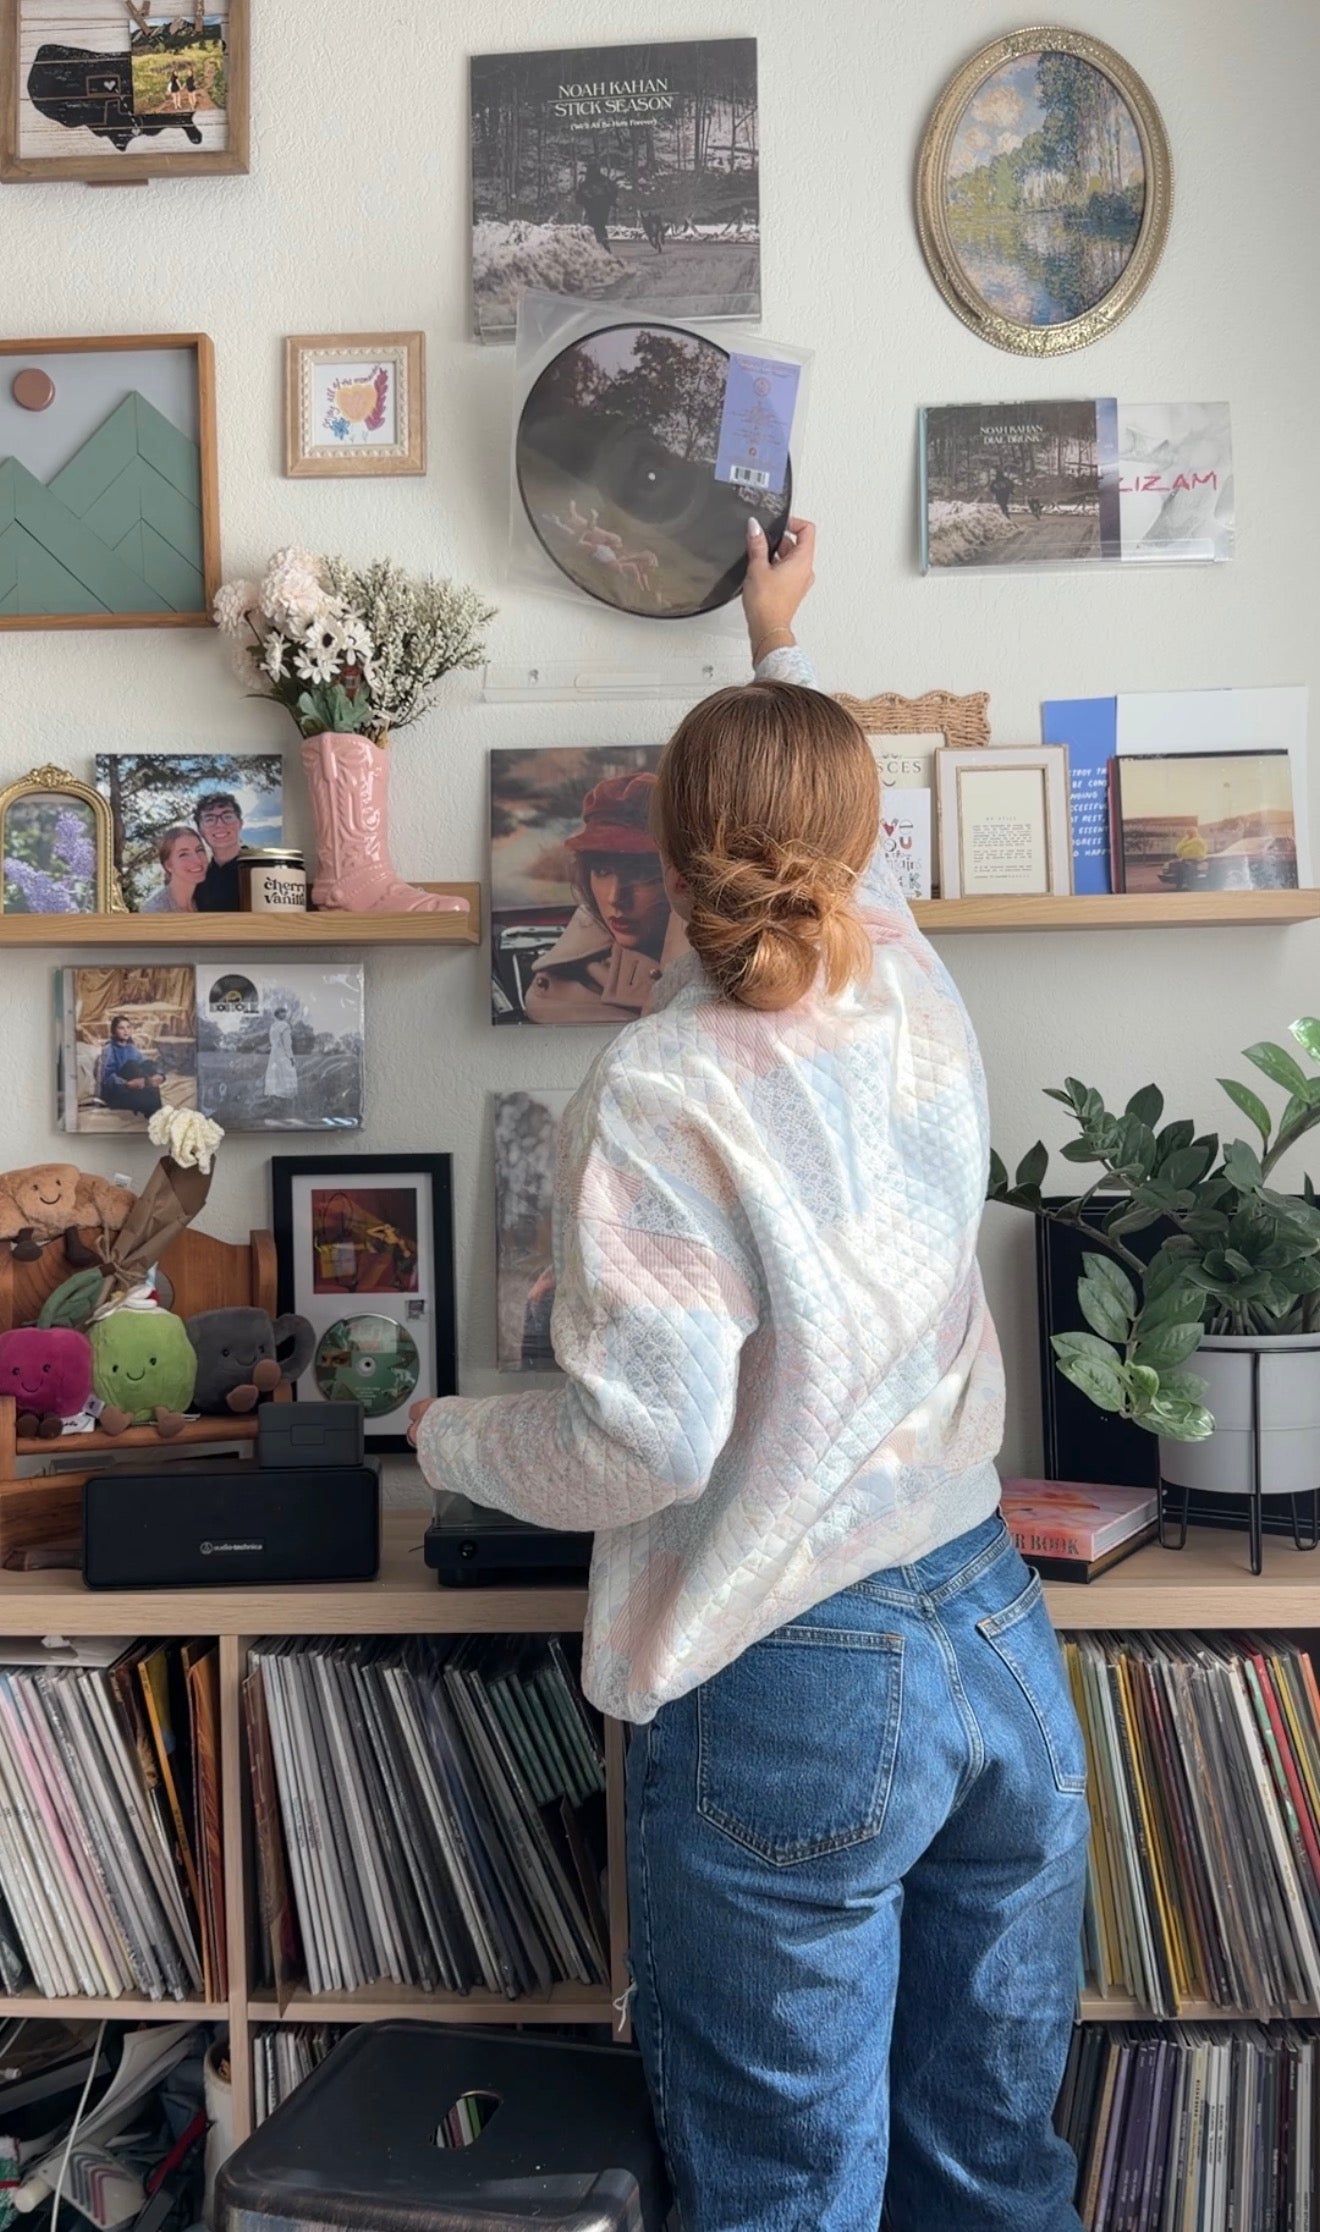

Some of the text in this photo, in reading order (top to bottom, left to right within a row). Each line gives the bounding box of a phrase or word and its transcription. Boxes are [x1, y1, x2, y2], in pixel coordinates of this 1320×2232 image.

[558, 78, 668, 99] NOAH KAHAN
[554, 96, 674, 117] STICK SEASON
